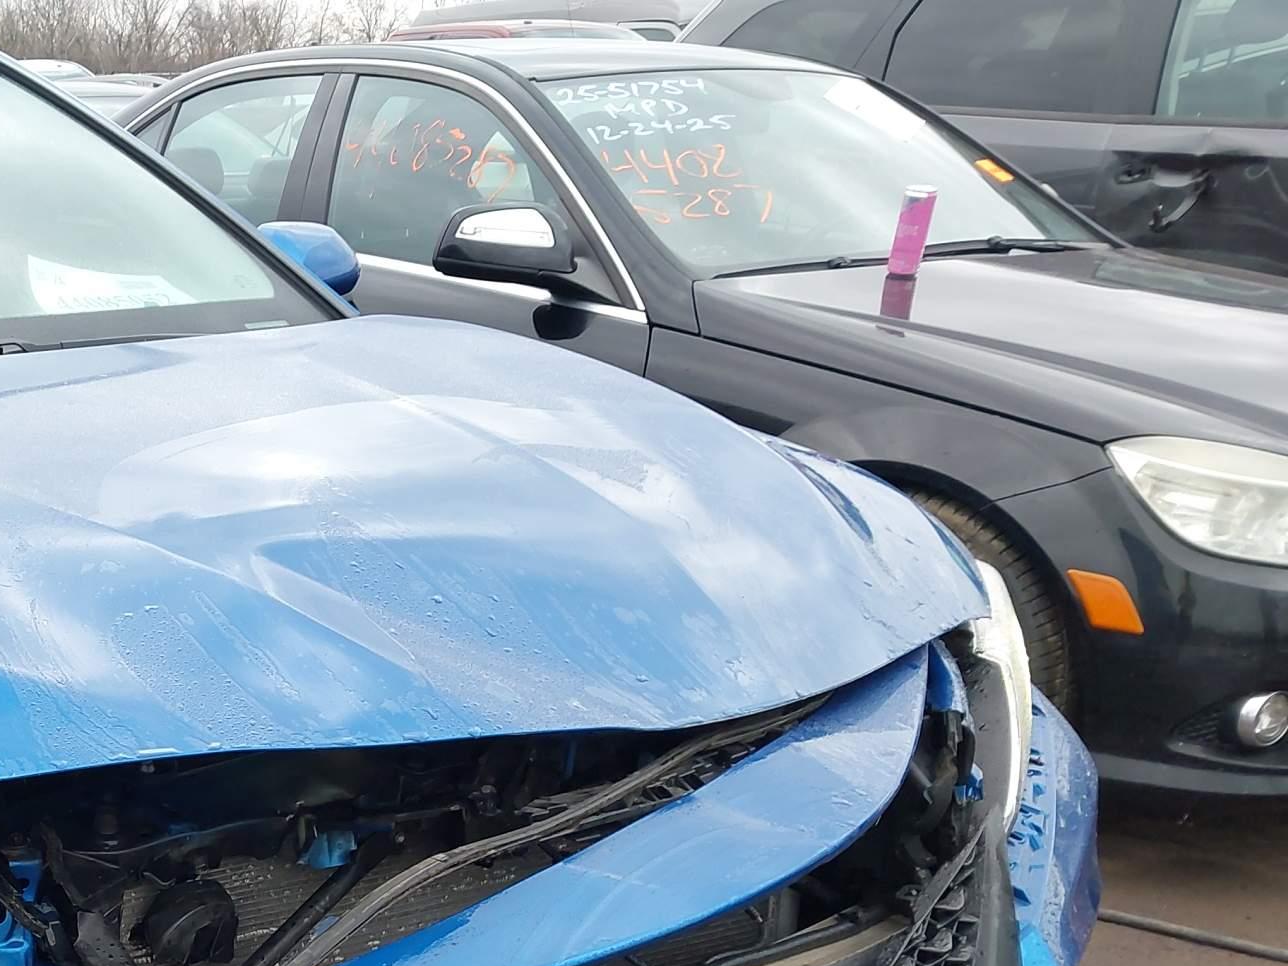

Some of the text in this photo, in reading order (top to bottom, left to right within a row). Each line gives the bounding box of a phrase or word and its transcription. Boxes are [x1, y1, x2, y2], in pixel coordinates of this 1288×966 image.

[555, 78, 708, 105] 25-51754
[603, 98, 689, 119] MPD
[586, 114, 737, 144] 12-24-25
